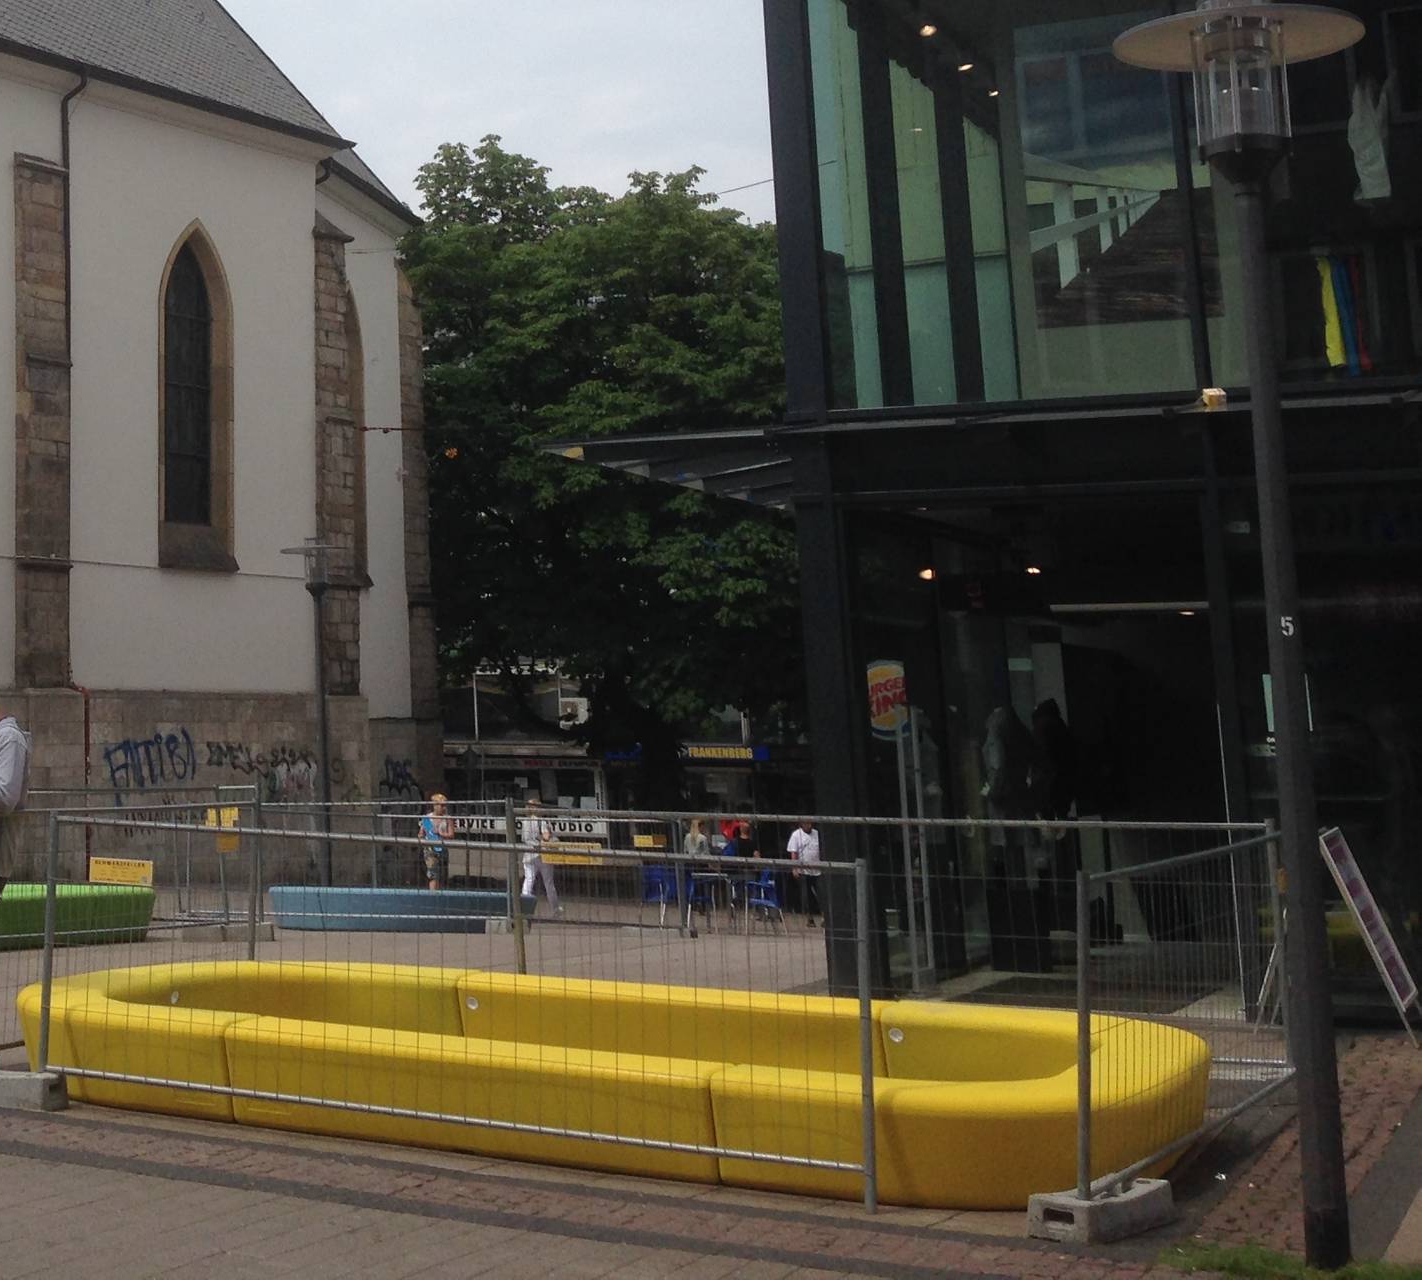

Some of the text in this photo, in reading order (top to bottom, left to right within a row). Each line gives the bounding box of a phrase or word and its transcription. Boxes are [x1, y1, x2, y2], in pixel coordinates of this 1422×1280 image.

[1280, 615, 1295, 637] 5
[688, 747, 754, 760] FRANKENBERG
[454, 818, 495, 830] ERVICE
[552, 821, 594, 833] TUDIO
